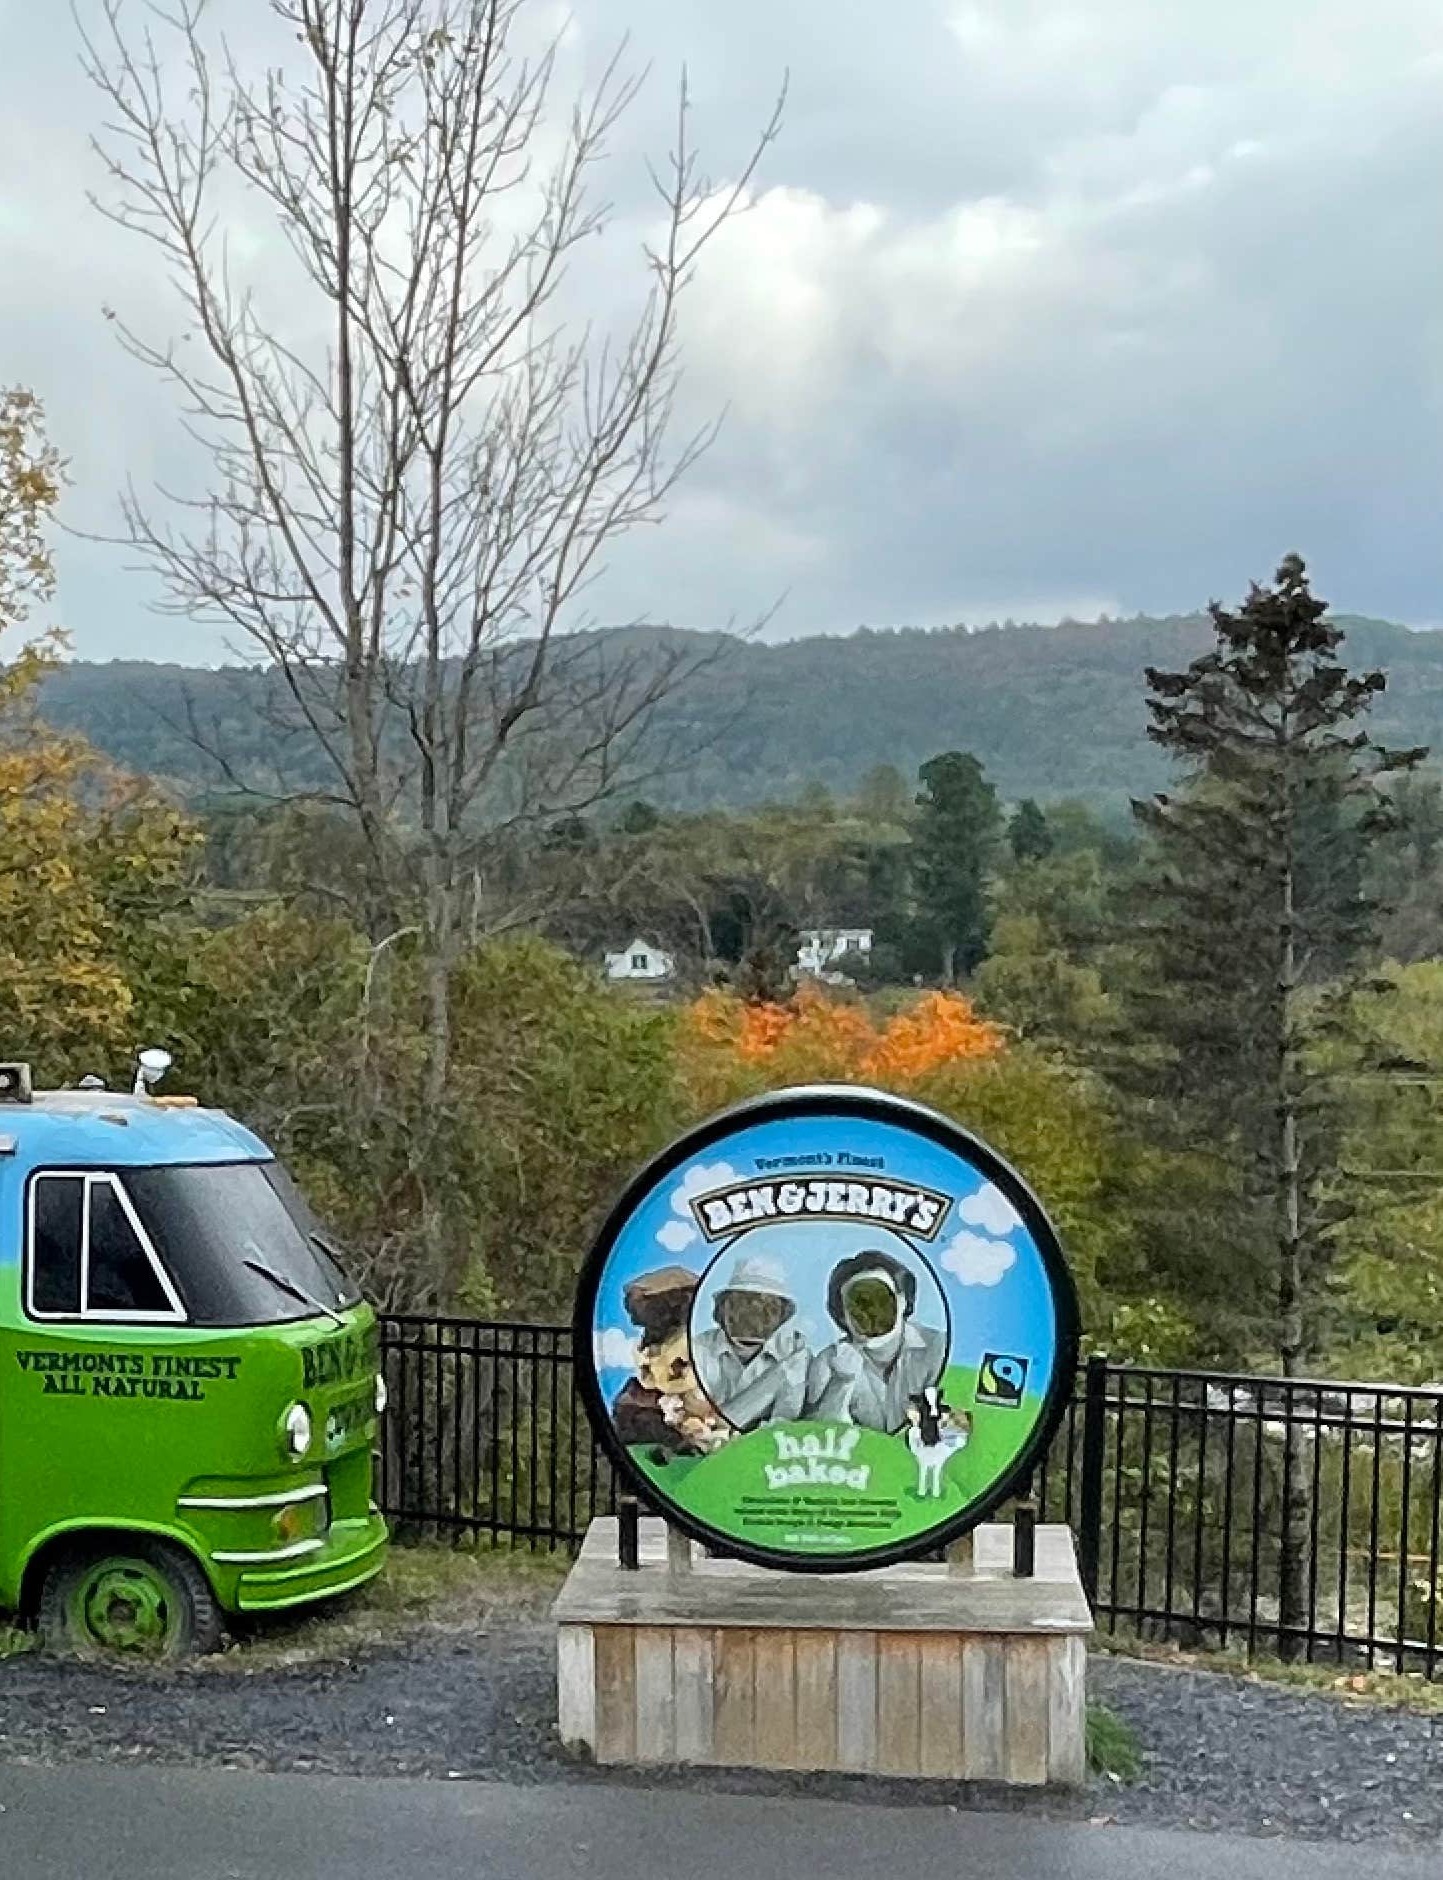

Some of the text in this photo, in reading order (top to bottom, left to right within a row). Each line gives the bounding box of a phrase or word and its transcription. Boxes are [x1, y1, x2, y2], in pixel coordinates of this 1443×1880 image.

[151, 1355, 241, 1380] FINEST
[43, 1374, 205, 1400] ALL NATURAL
[773, 1426, 861, 1461] half
[764, 1456, 870, 1491] baked
